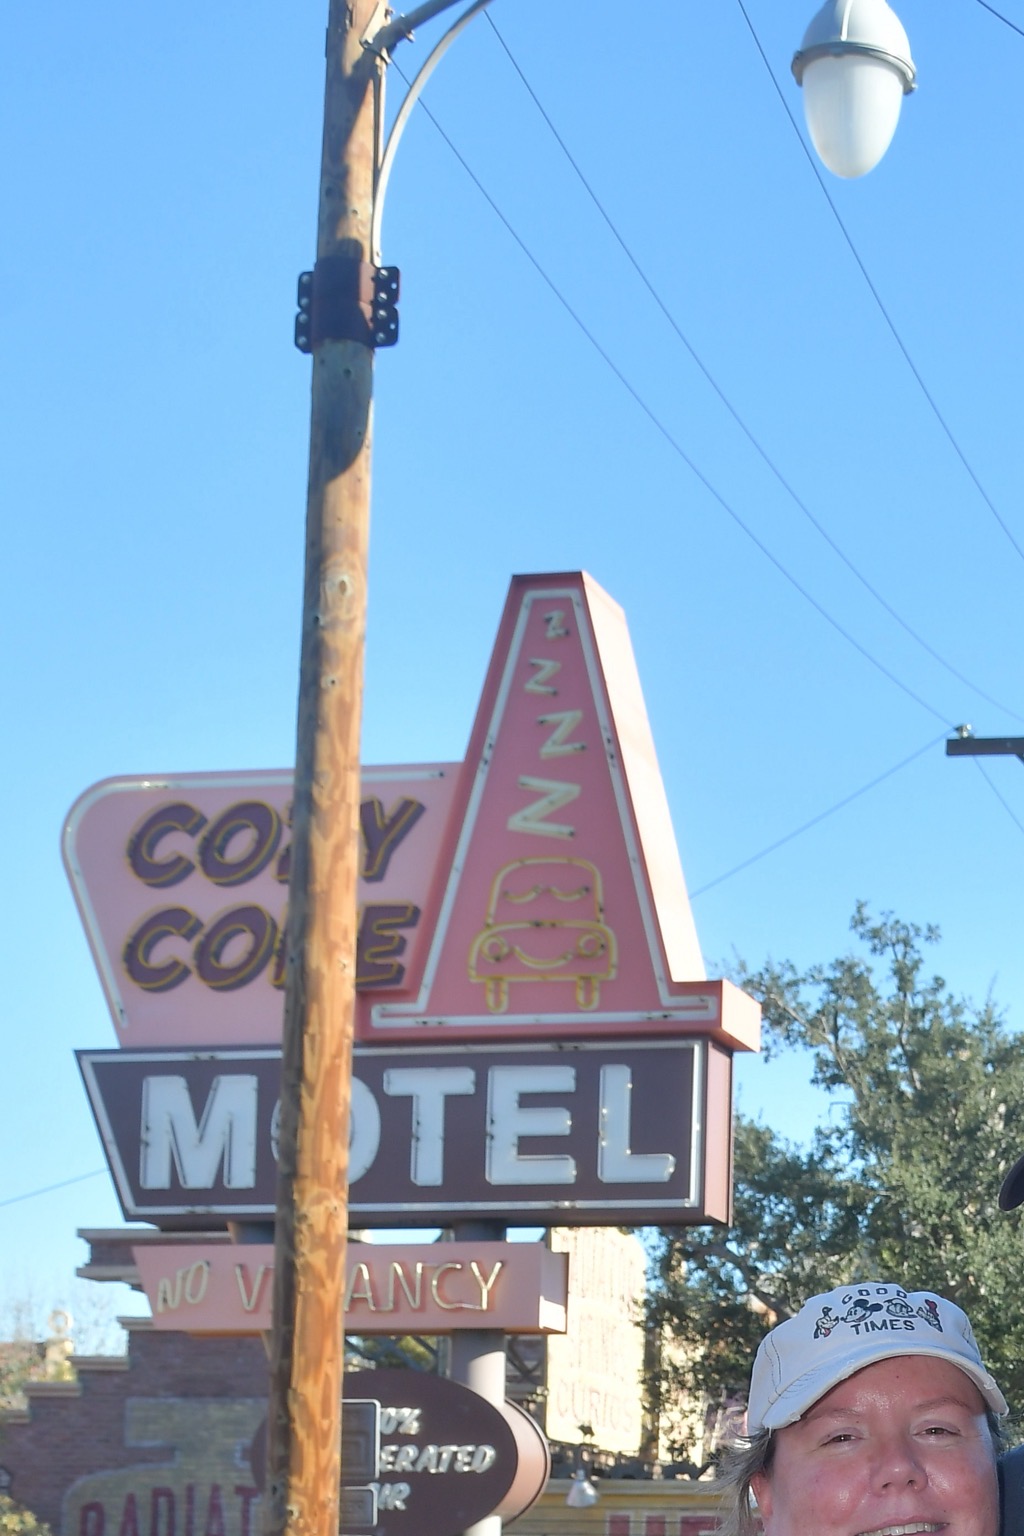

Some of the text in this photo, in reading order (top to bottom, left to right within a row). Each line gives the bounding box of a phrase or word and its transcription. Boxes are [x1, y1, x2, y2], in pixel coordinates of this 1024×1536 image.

[127, 797, 426, 888] COY
[123, 898, 421, 992] COE
[156, 1260, 503, 1313] NO VANCY
[841, 1287, 908, 1305] GOOD
[850, 1318, 916, 1335] TIMES
[380, 1444, 496, 1474] ERATED
